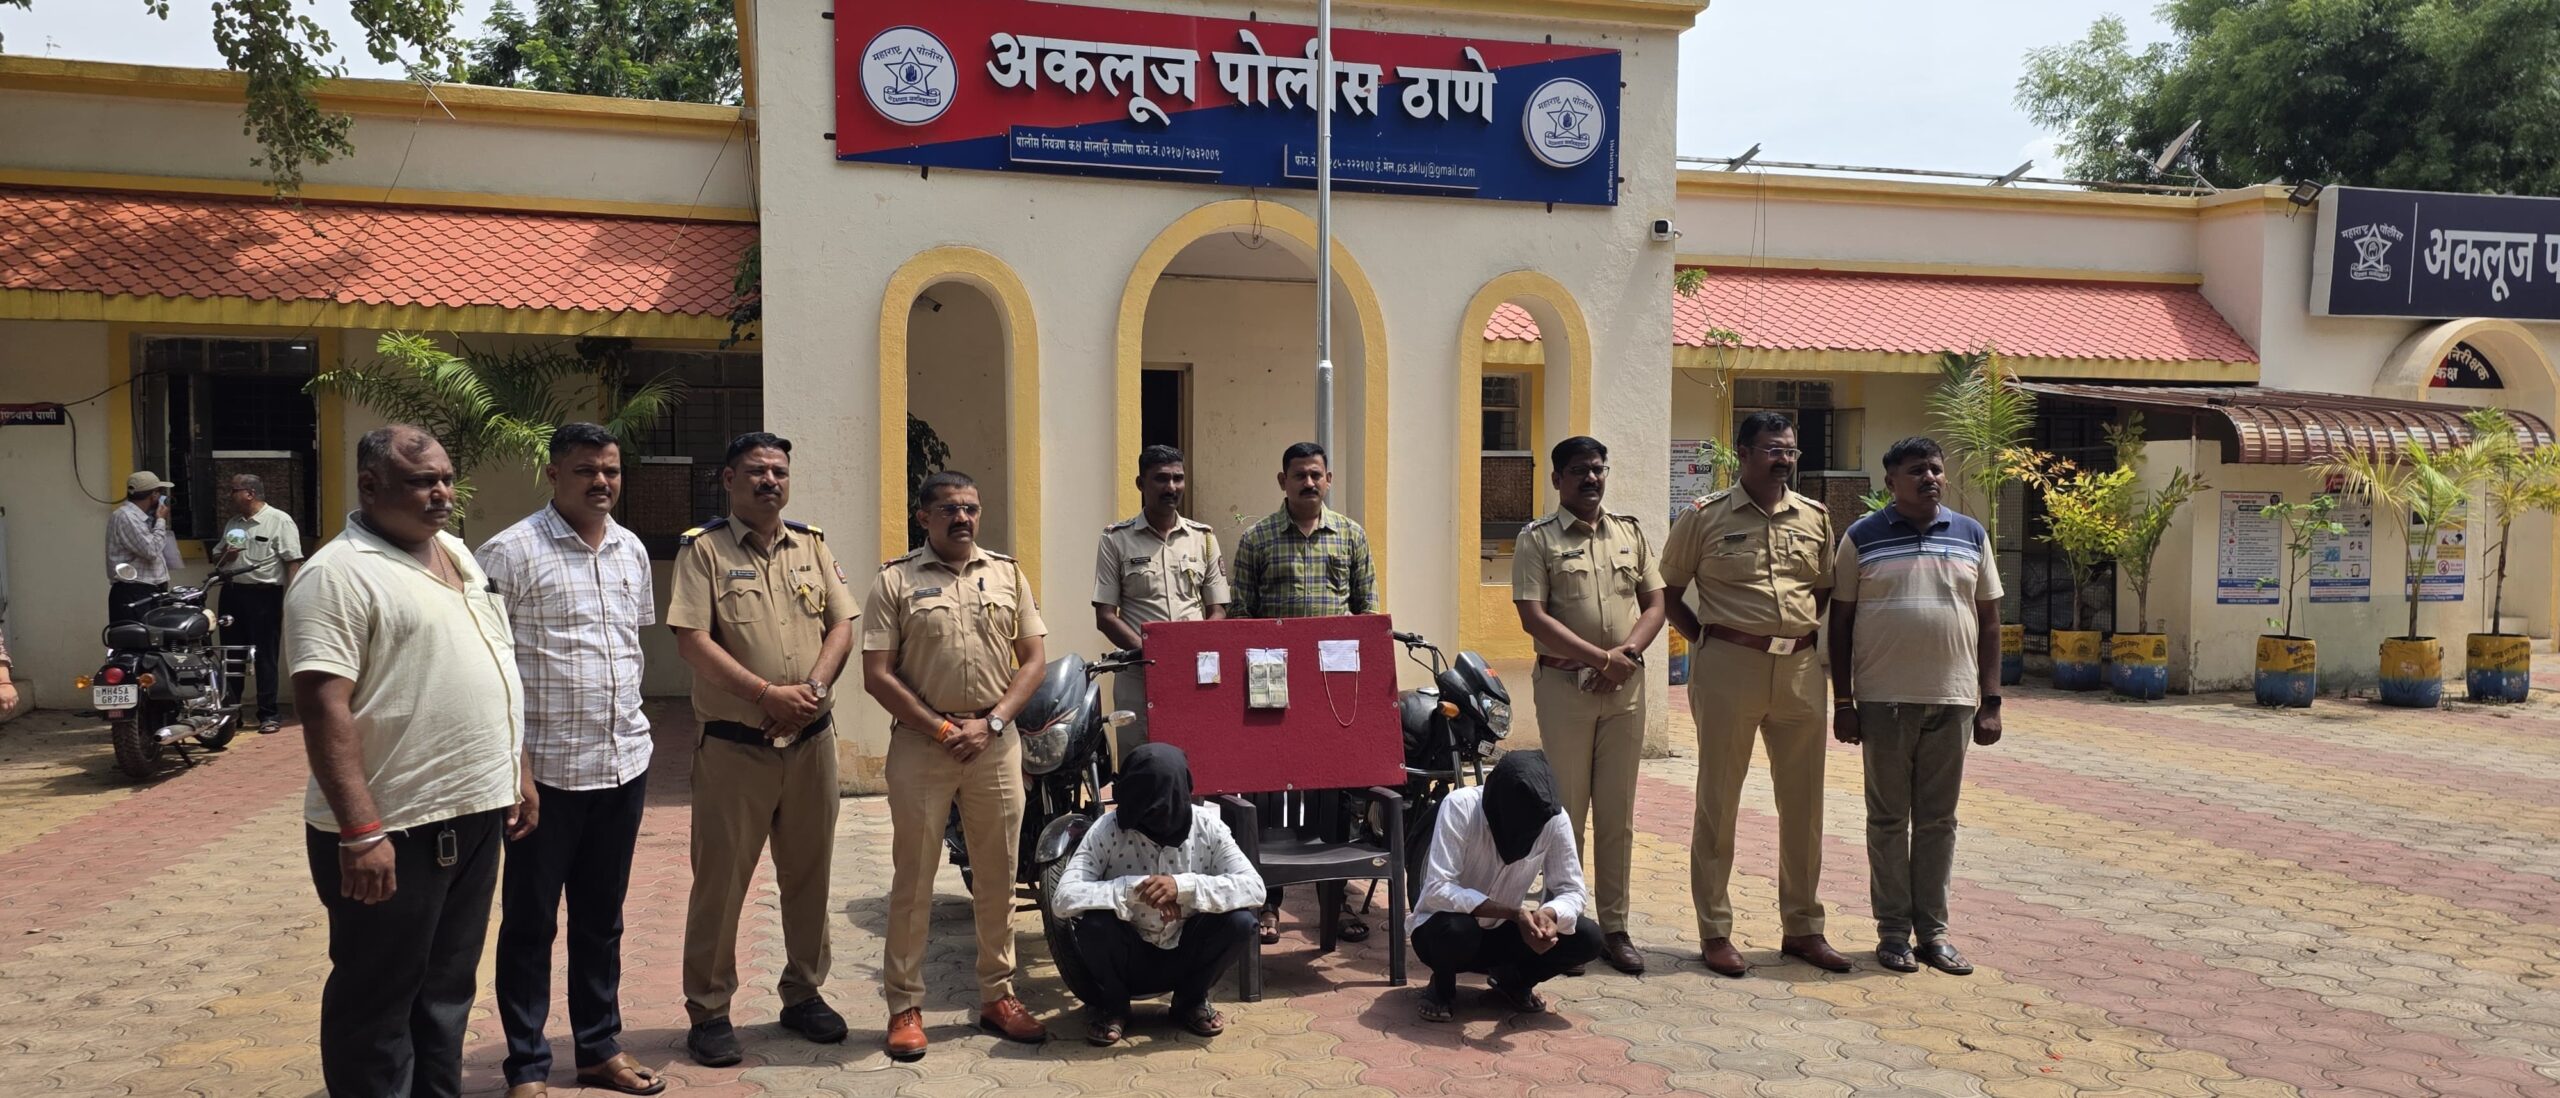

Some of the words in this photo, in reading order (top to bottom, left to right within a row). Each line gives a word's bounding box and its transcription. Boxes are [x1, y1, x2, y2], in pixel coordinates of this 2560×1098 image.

[915, 44, 944, 63] पोलीस
[986, 32, 1201, 127] अकलूज
[1396, 46, 1498, 124] ठाणे
[1016, 132, 1040, 149] पोलीस
[1041, 133, 1066, 150] नियंत्रण
[1068, 139, 1082, 153] कक्ष
[1112, 139, 1134, 155] ग्रामीण
[2424, 229, 2538, 302] अकलूज
[2434, 367, 2459, 382] कक्ष
